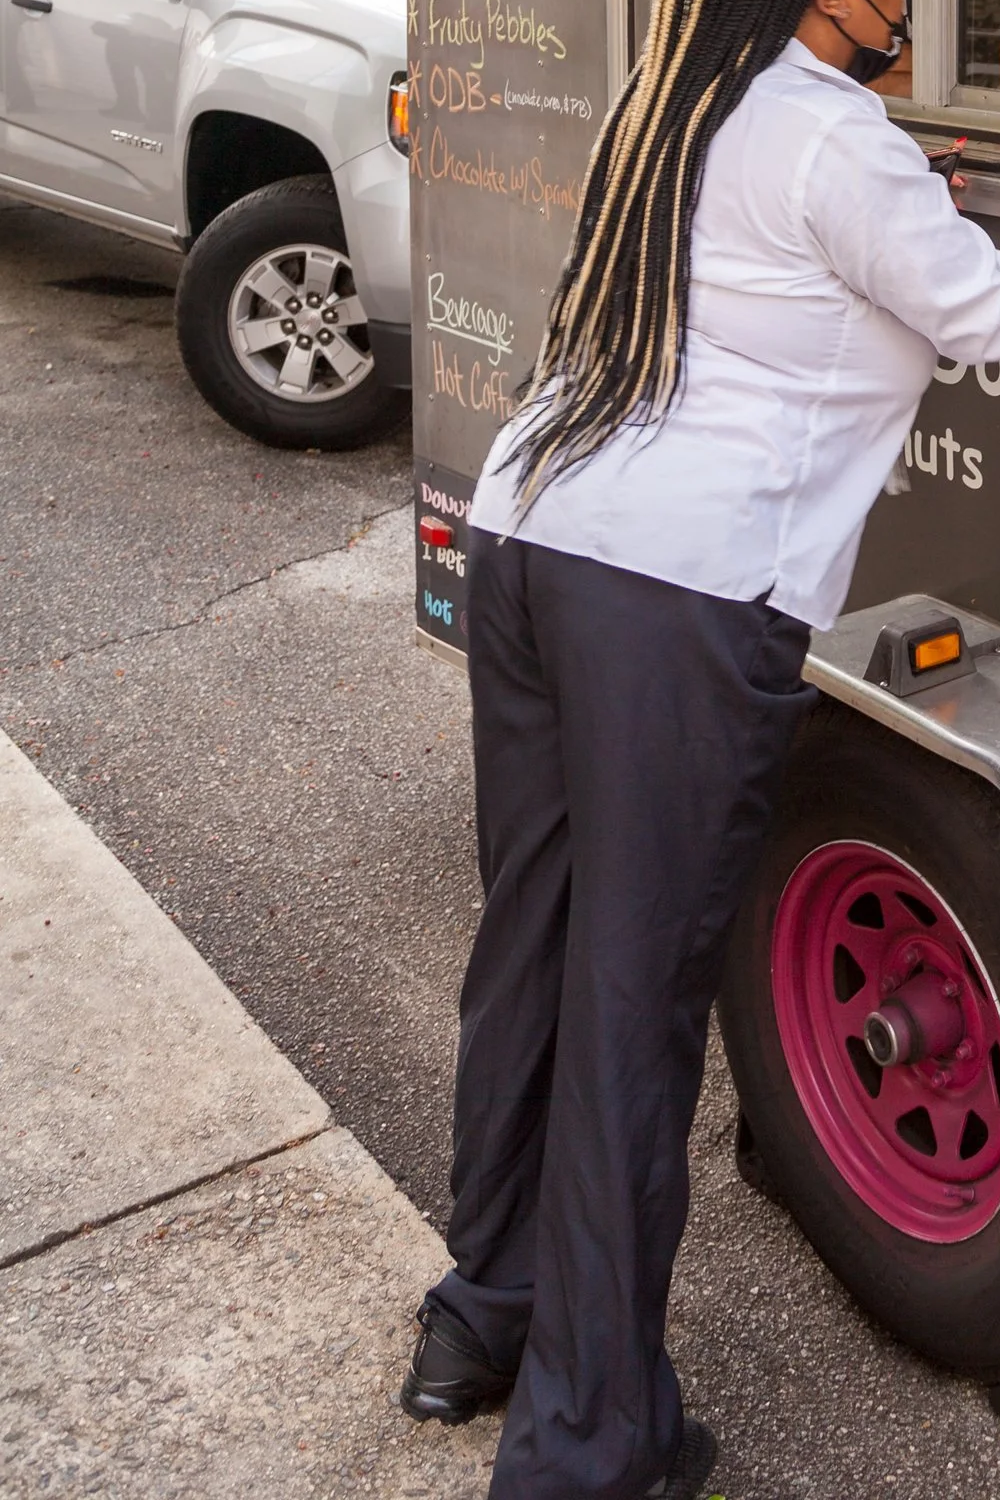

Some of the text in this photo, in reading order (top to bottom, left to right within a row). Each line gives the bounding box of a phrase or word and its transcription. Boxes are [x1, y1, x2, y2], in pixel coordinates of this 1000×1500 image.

[430, 63, 486, 112] ODB
[430, 125, 508, 194] Chocolate
[531, 156, 581, 221] Sprink
[427, 272, 515, 367] Beverage:
[432, 339, 467, 408] Hot
